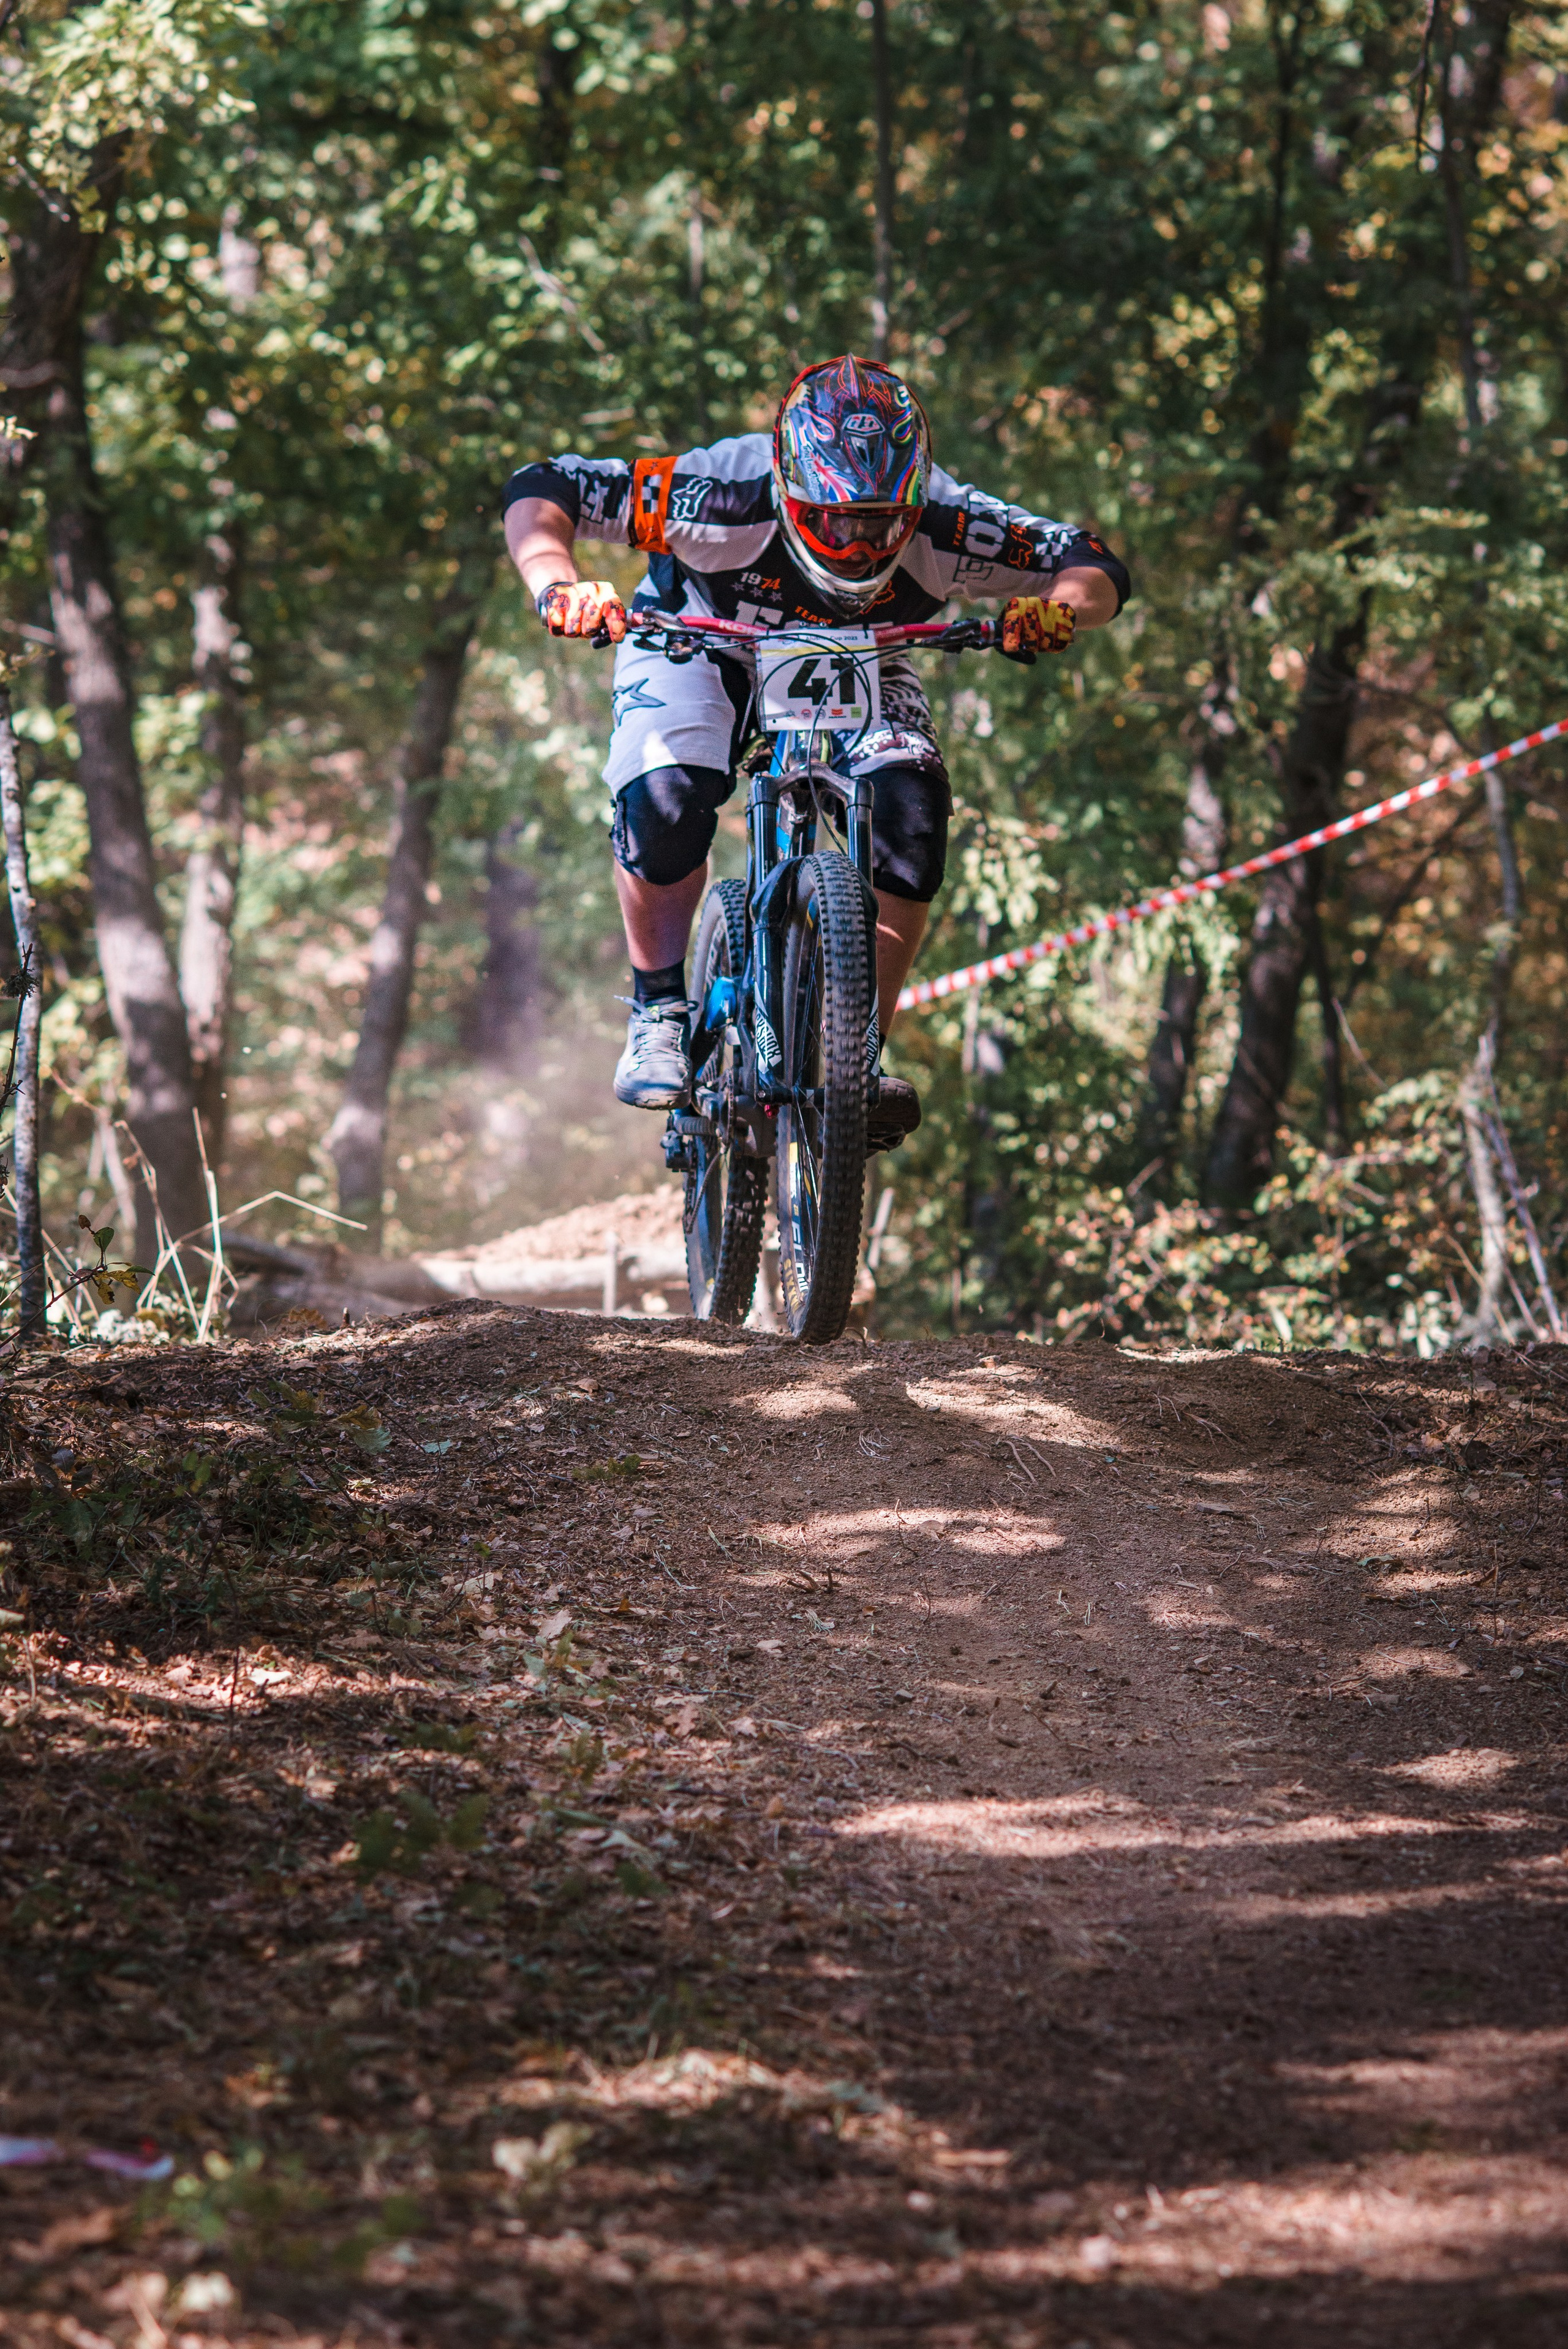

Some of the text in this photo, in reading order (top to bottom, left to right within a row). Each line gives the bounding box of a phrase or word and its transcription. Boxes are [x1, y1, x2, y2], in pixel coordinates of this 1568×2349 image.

[952, 511, 965, 546] TEAM
[741, 572, 780, 590] 1974
[795, 606, 833, 625] TEAM
[788, 658, 856, 706] 41
